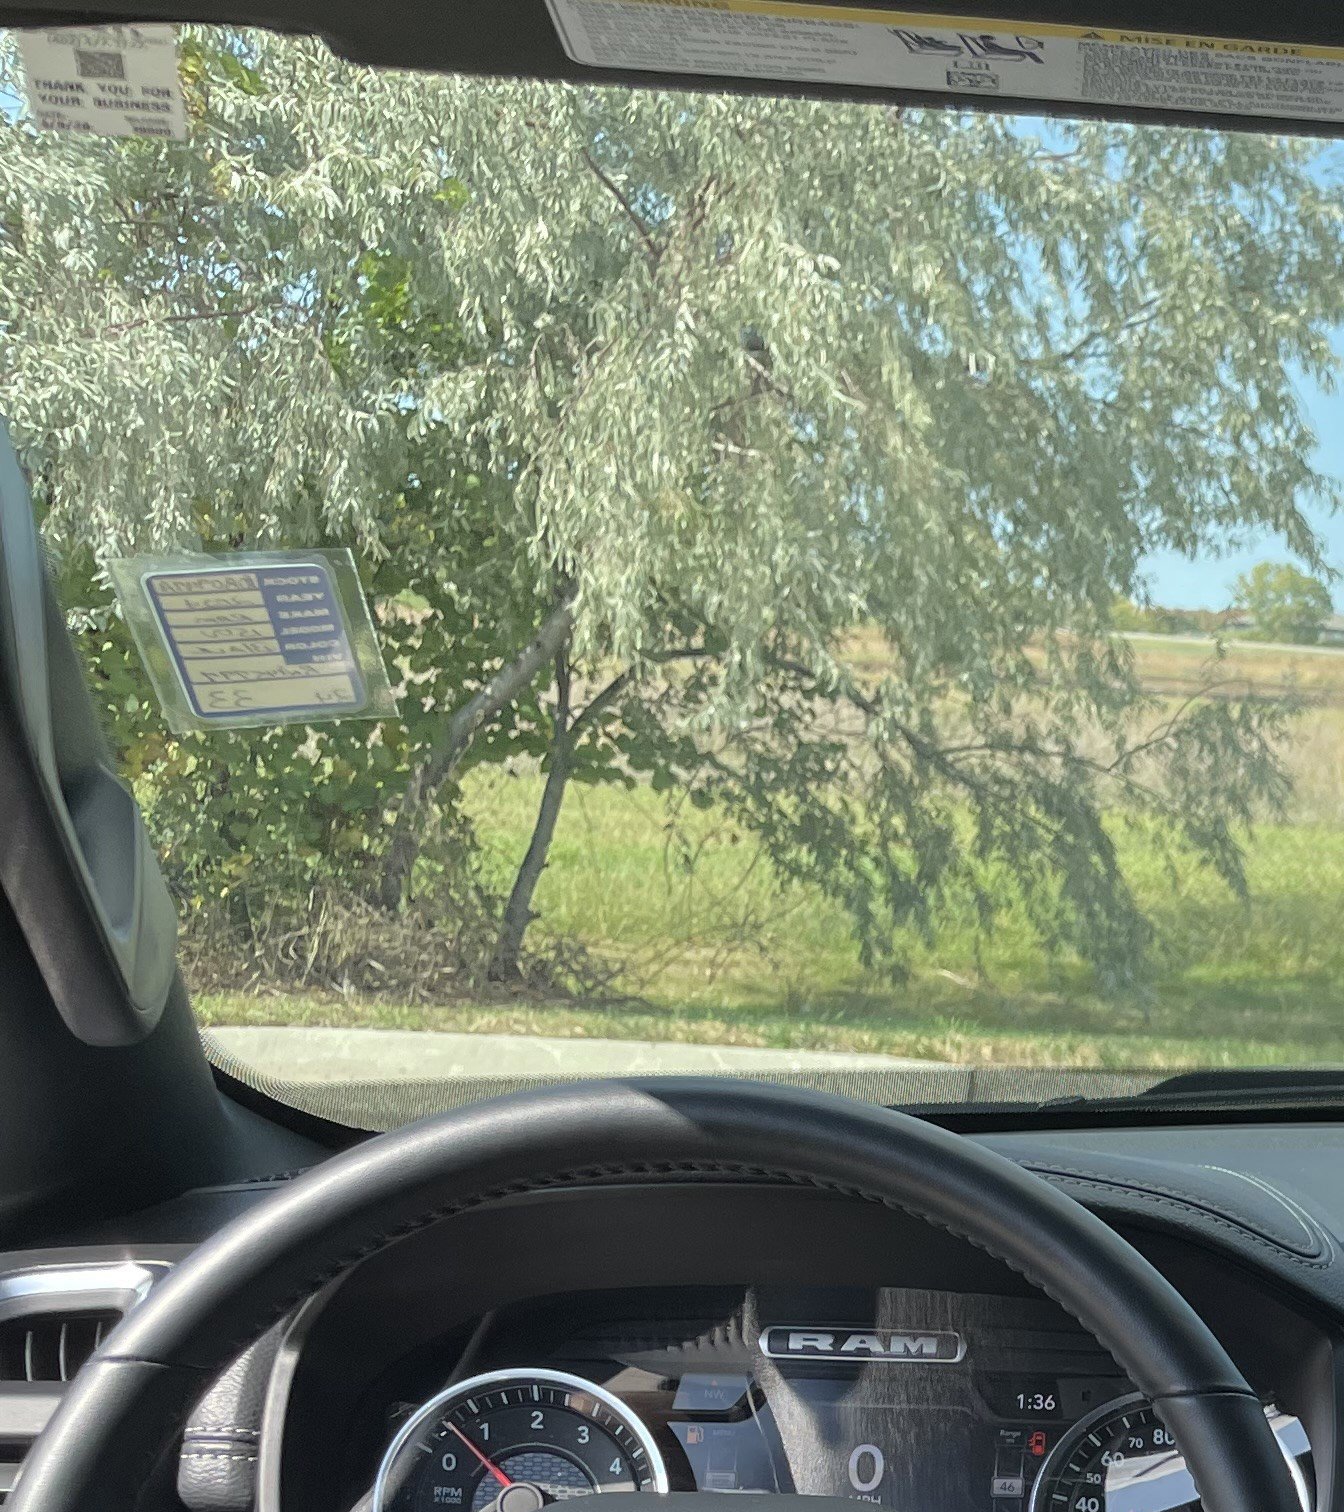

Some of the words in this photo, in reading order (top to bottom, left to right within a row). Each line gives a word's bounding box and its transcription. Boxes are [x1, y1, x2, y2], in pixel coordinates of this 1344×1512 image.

[34, 79, 85, 93] THANK
[97, 83, 129, 96] YOU
[141, 86, 171, 98] FOR
[38, 93, 81, 106] YOUR
[93, 97, 171, 112] BUSINESS
[788, 1333, 938, 1354] RAM
[1016, 1394, 1056, 1410] 1:36
[531, 1411, 544, 1429] 2
[479, 1422, 490, 1441] 1
[577, 1425, 590, 1443] 3
[1128, 1436, 1144, 1448] 70
[441, 1453, 457, 1471] 0
[609, 1457, 622, 1475] 4
[848, 1443, 885, 1492] 0
[1100, 1450, 1125, 1467] 60
[1085, 1472, 1101, 1484] 50
[433, 1486, 463, 1497] RPM
[1000, 1482, 1015, 1493] 46
[1075, 1497, 1099, 1512] 40
